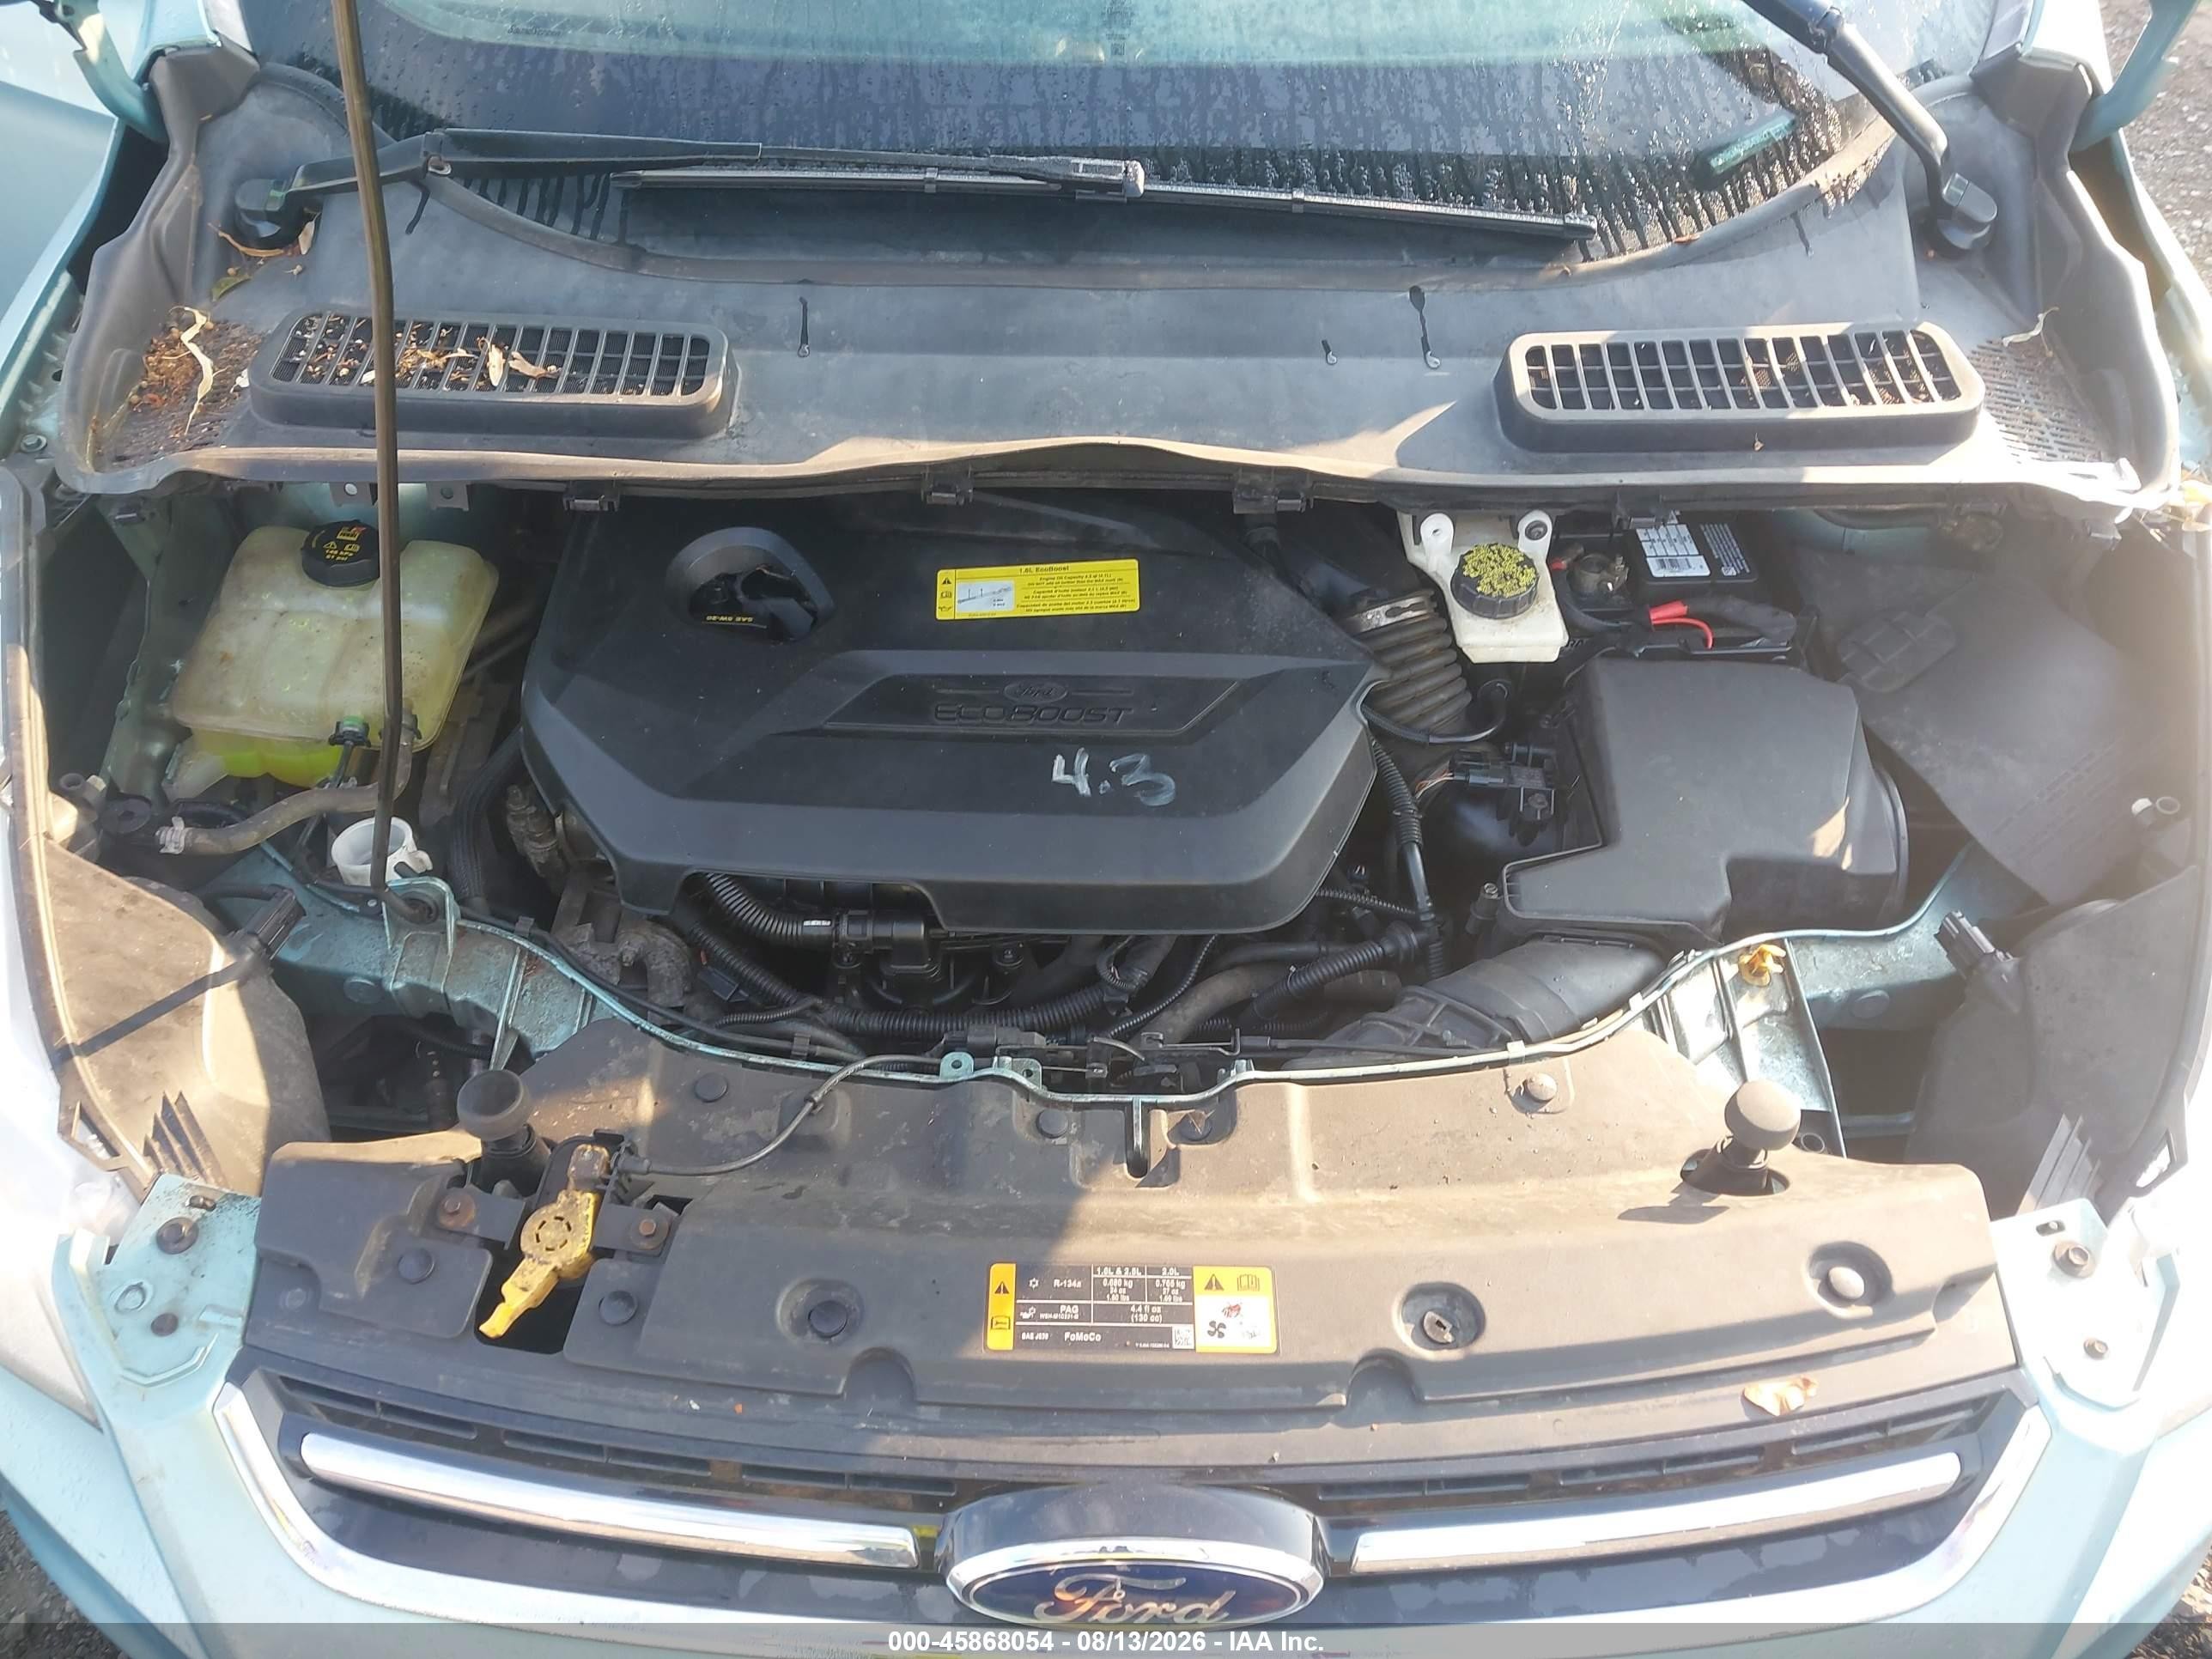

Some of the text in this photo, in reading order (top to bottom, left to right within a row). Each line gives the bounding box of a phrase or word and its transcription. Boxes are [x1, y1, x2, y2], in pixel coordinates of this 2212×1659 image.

[1035, 565, 1070, 574] EcoBoost
[1051, 747, 1176, 806] 4.3
[1115, 1267, 1122, 1276] &
[1162, 1267, 1180, 1277] 2.0L
[1054, 1279, 1082, 1289] R-134a
[1123, 1279, 1133, 1289] kg
[1176, 1279, 1186, 1290] kg
[1060, 1305, 1079, 1314] PAG
[1131, 1313, 1149, 1322] (130
[1064, 1332, 1102, 1342] FoMoCo
[1034, 1572, 1237, 1625] Ford
